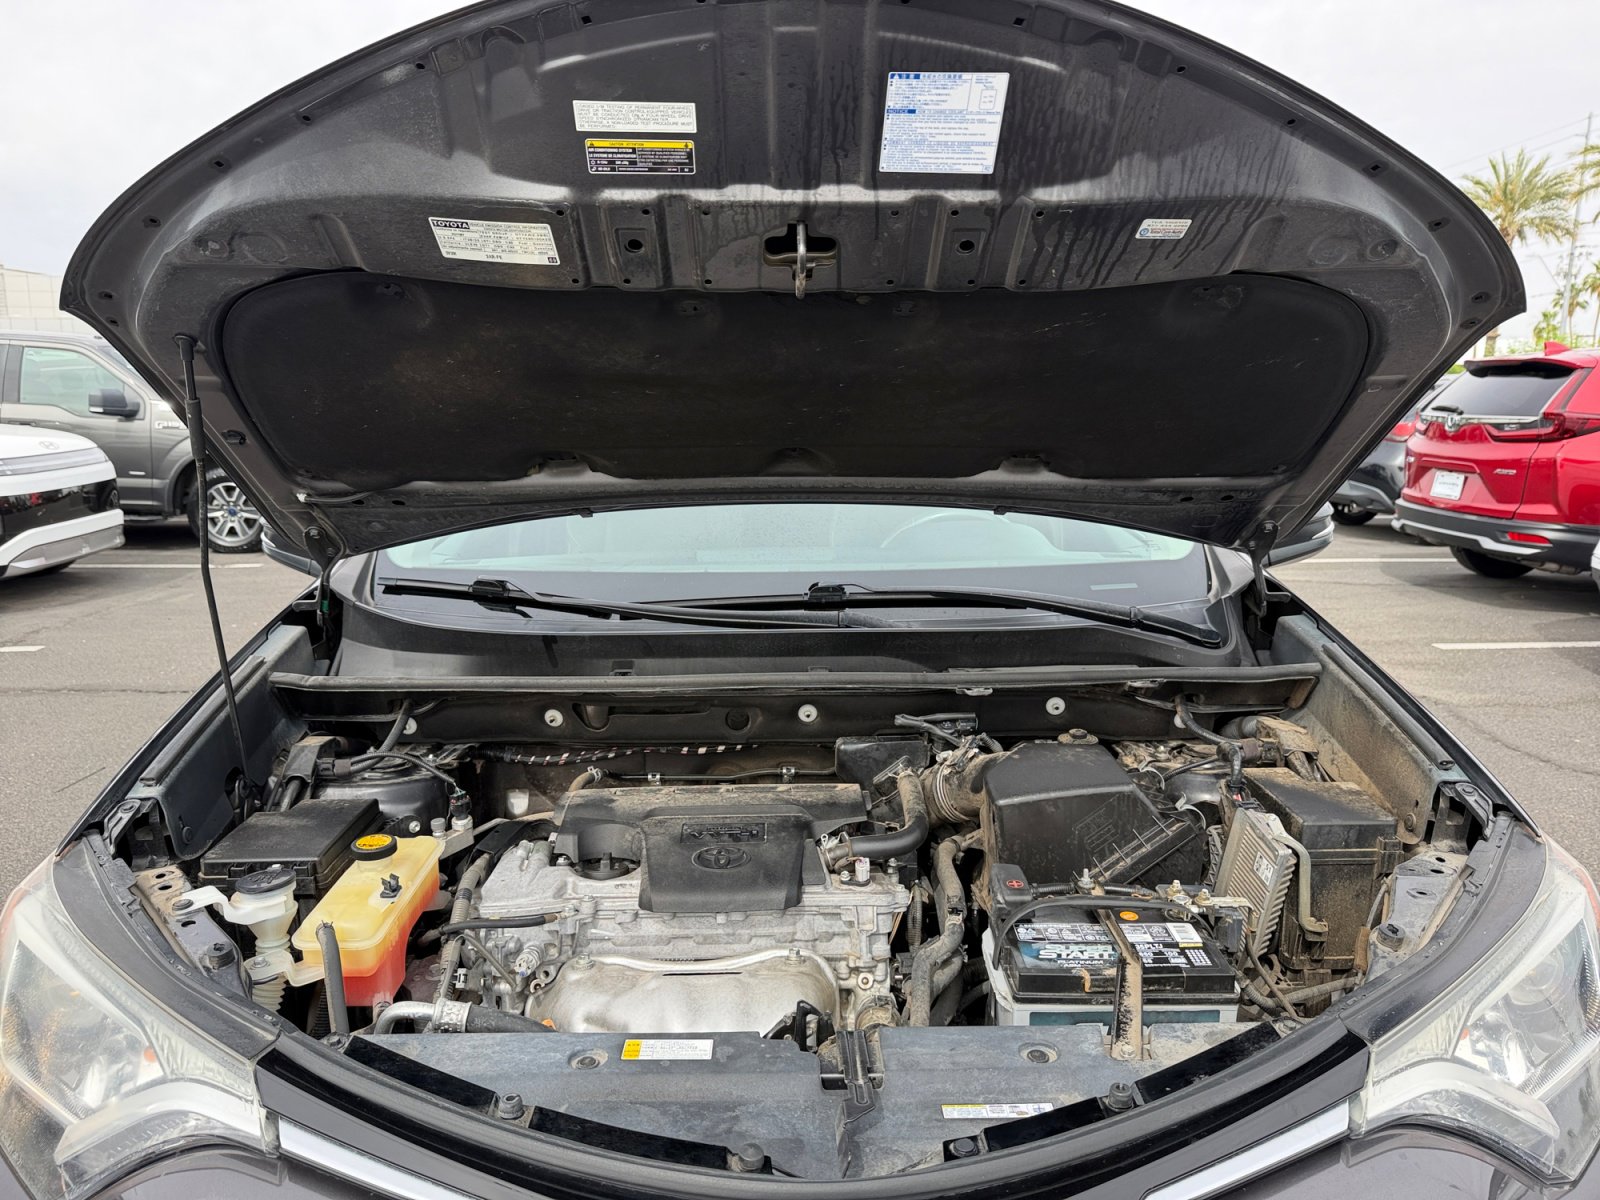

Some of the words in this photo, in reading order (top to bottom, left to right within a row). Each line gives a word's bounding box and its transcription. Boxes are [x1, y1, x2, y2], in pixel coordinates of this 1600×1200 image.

[432, 220, 470, 229] TOYOTA
[1045, 943, 1113, 952] SUPER
[1039, 950, 1116, 959] START
